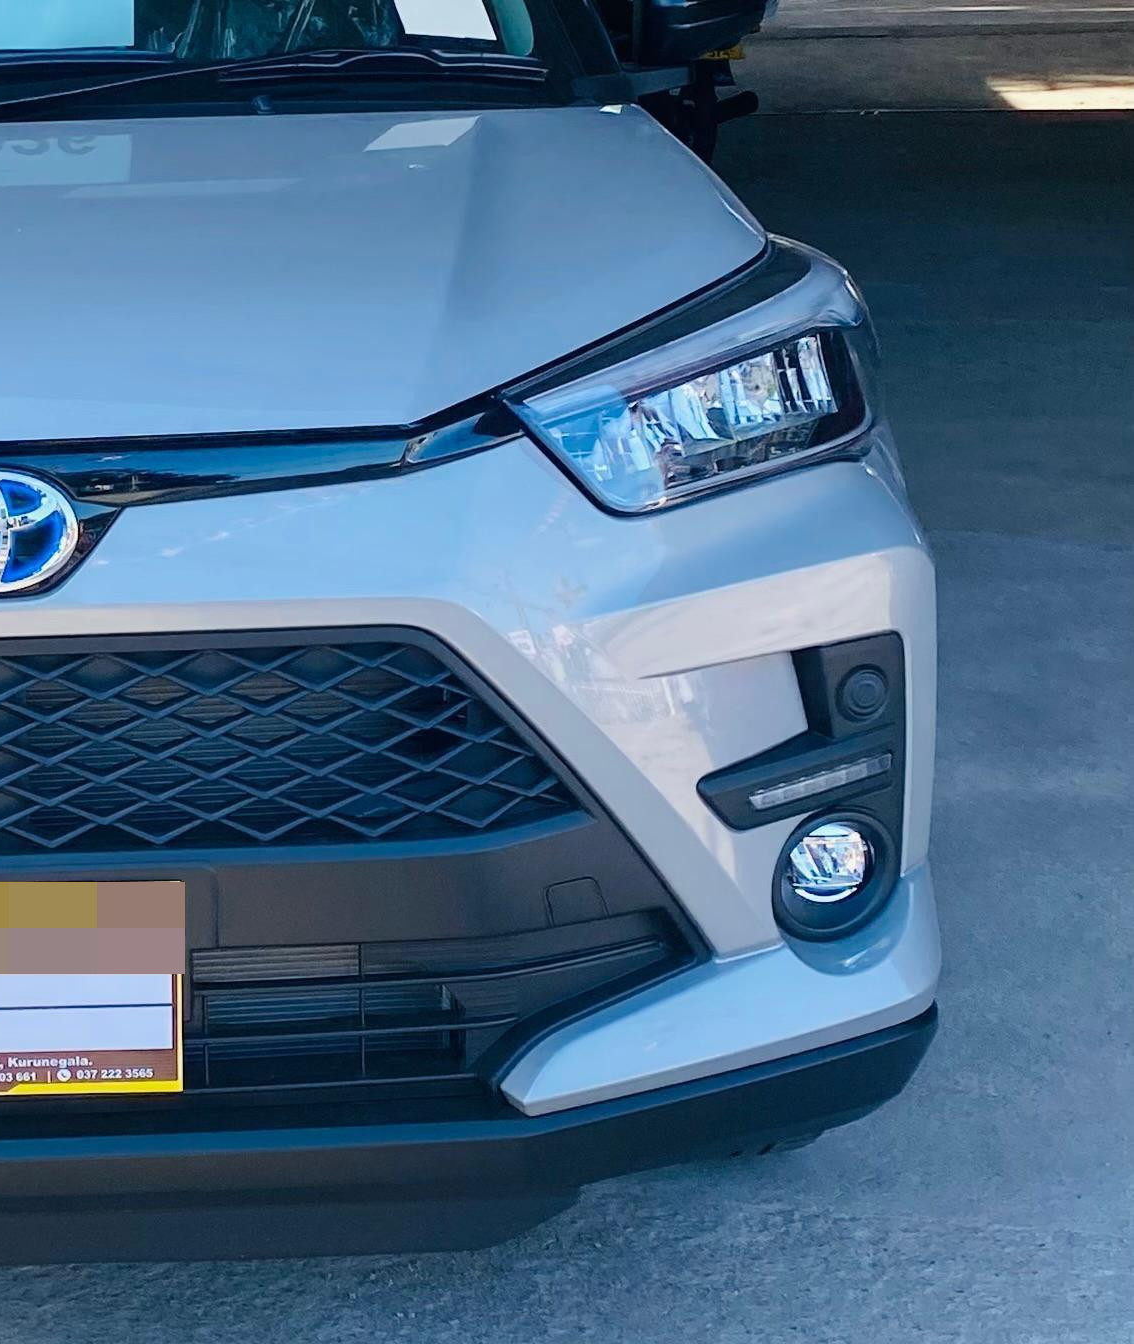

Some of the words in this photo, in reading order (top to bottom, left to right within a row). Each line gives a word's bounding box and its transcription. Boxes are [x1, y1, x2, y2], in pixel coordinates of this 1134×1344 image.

[8, 1056, 93, 1069] Kurunegala.
[76, 1069, 98, 1080] 037
[101, 1069, 122, 1079] 222
